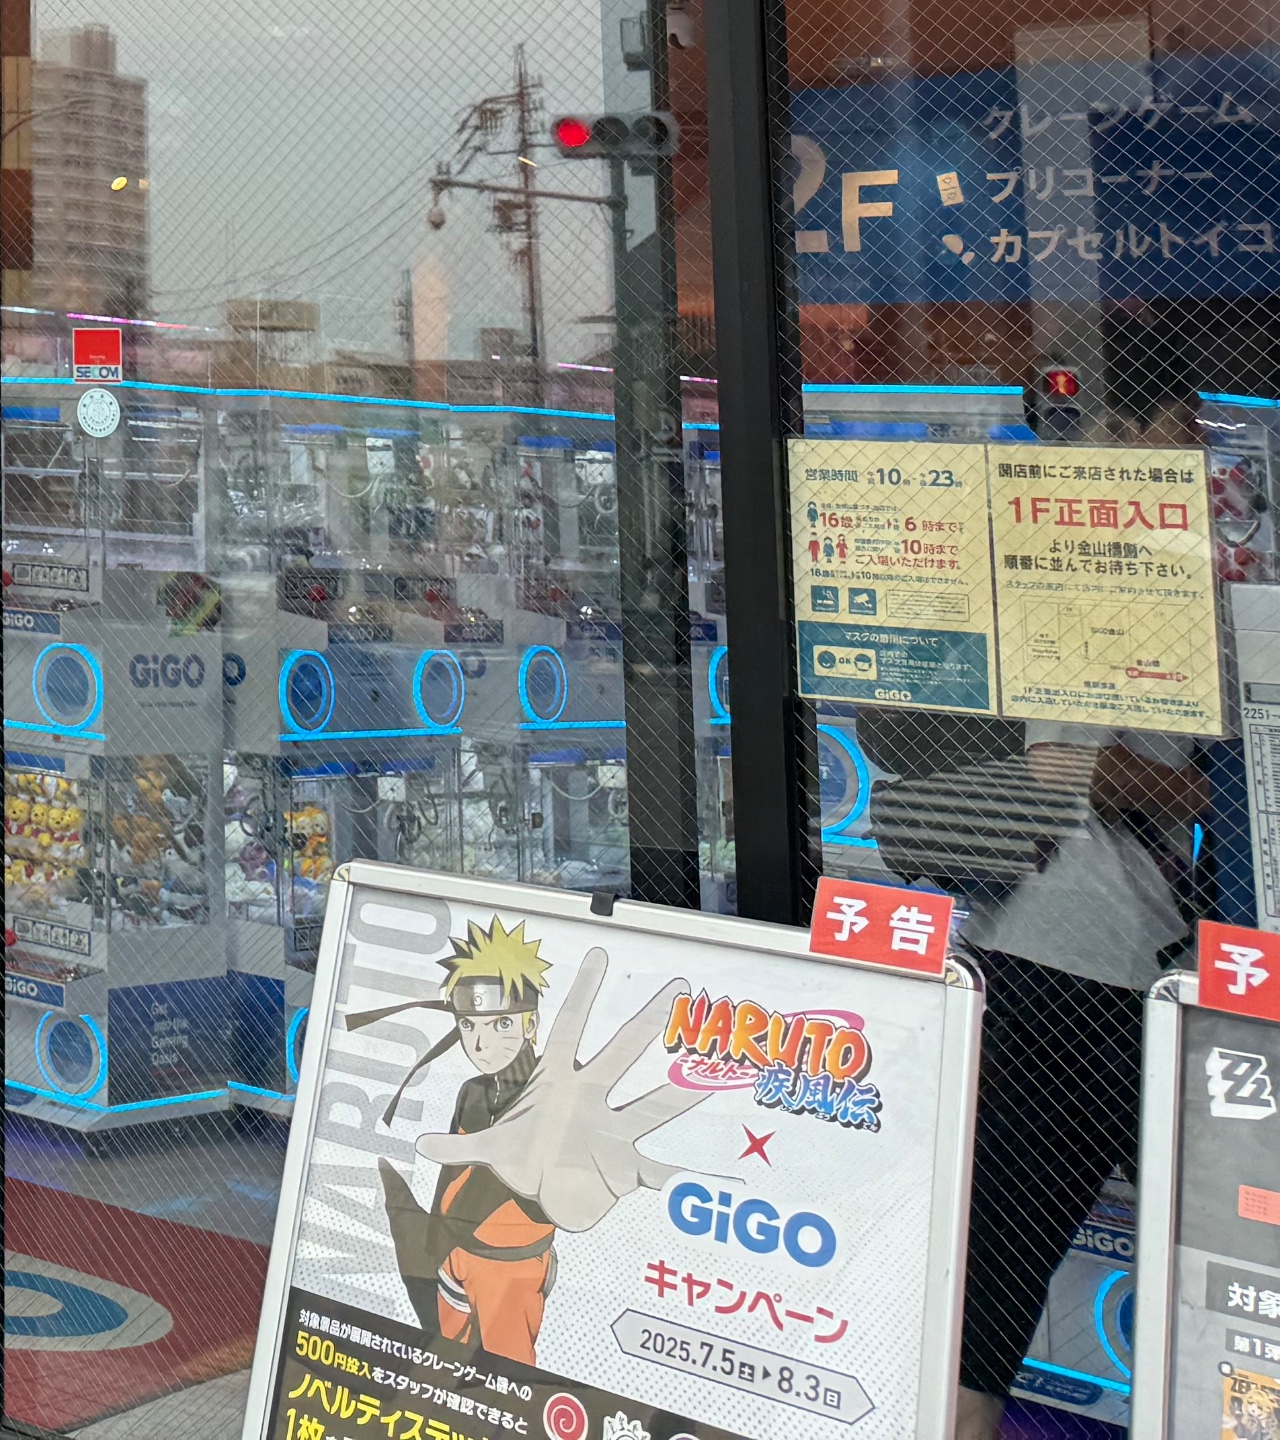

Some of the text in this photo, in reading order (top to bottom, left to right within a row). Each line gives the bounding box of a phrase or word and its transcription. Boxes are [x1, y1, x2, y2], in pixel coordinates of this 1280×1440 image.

[987, 160, 1216, 205] プリコーナー
[76, 366, 120, 380] SECOM
[1008, 496, 1189, 532] 1F正面入口
[1003, 554, 1192, 580] 順番に並んでお待ち下さい。
[130, 653, 205, 688] GiGO
[874, 688, 913, 702] GiGO
[826, 896, 936, 955] 予告
[664, 988, 870, 1084] NARUTO
[754, 1060, 881, 1128] 疾風伝
[666, 1181, 837, 1269] GiGO
[643, 1259, 849, 1345] キャンペーン
